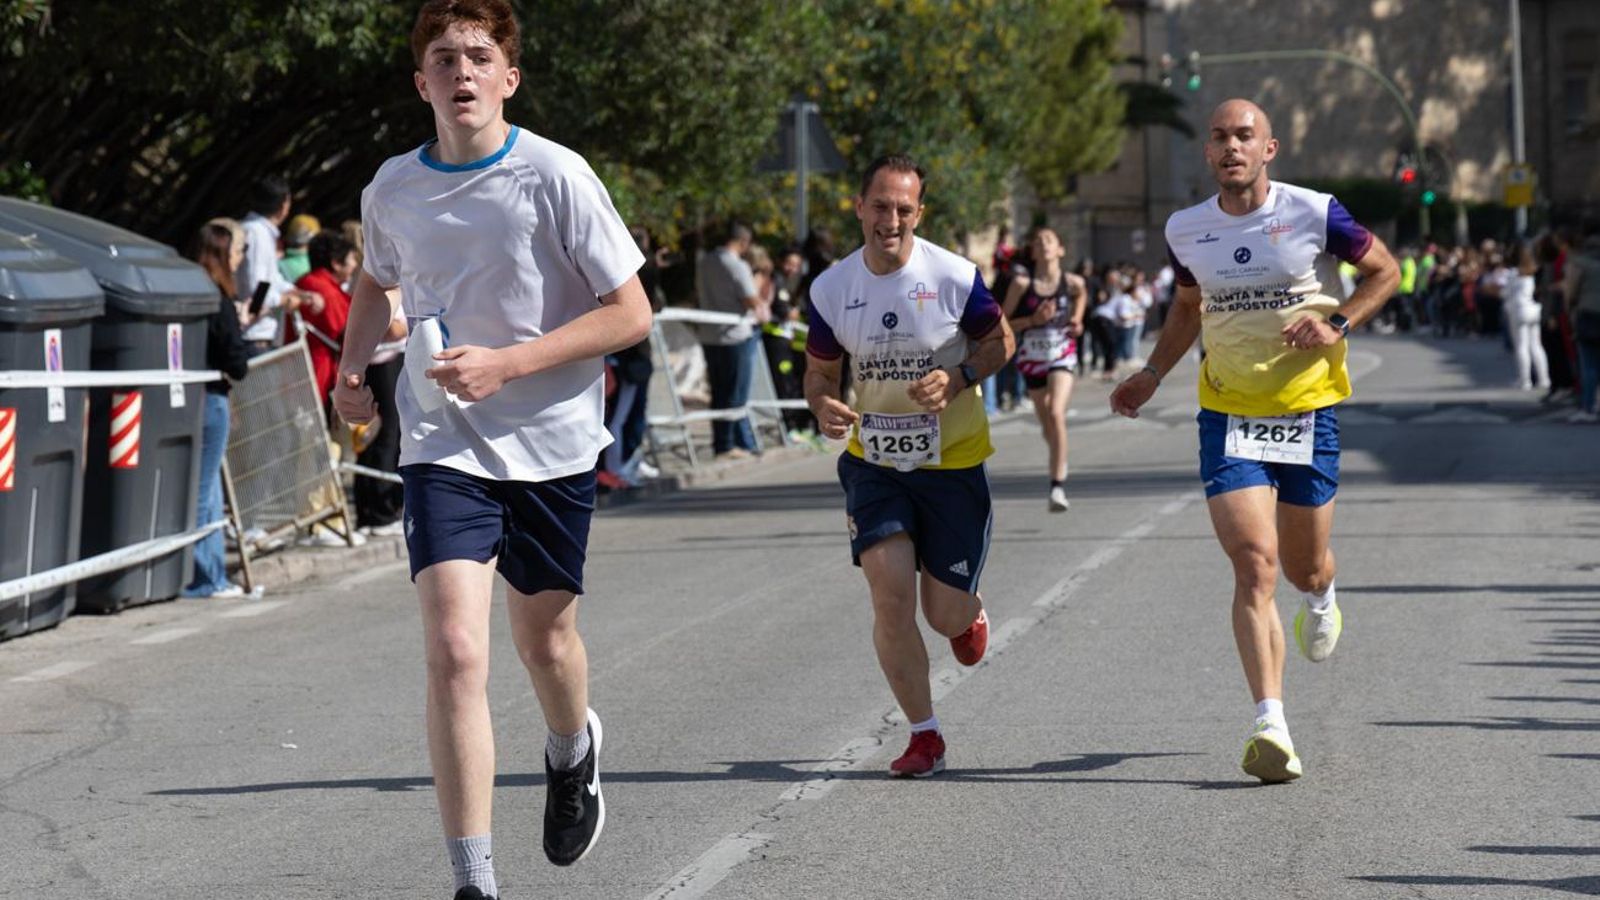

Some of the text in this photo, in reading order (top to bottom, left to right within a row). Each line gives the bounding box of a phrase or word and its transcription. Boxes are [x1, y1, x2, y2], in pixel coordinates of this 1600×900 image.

[858, 359, 897, 371] SANTA
[917, 356, 934, 368] DE
[1239, 422, 1302, 444] 1262
[868, 434, 930, 453] 1263
